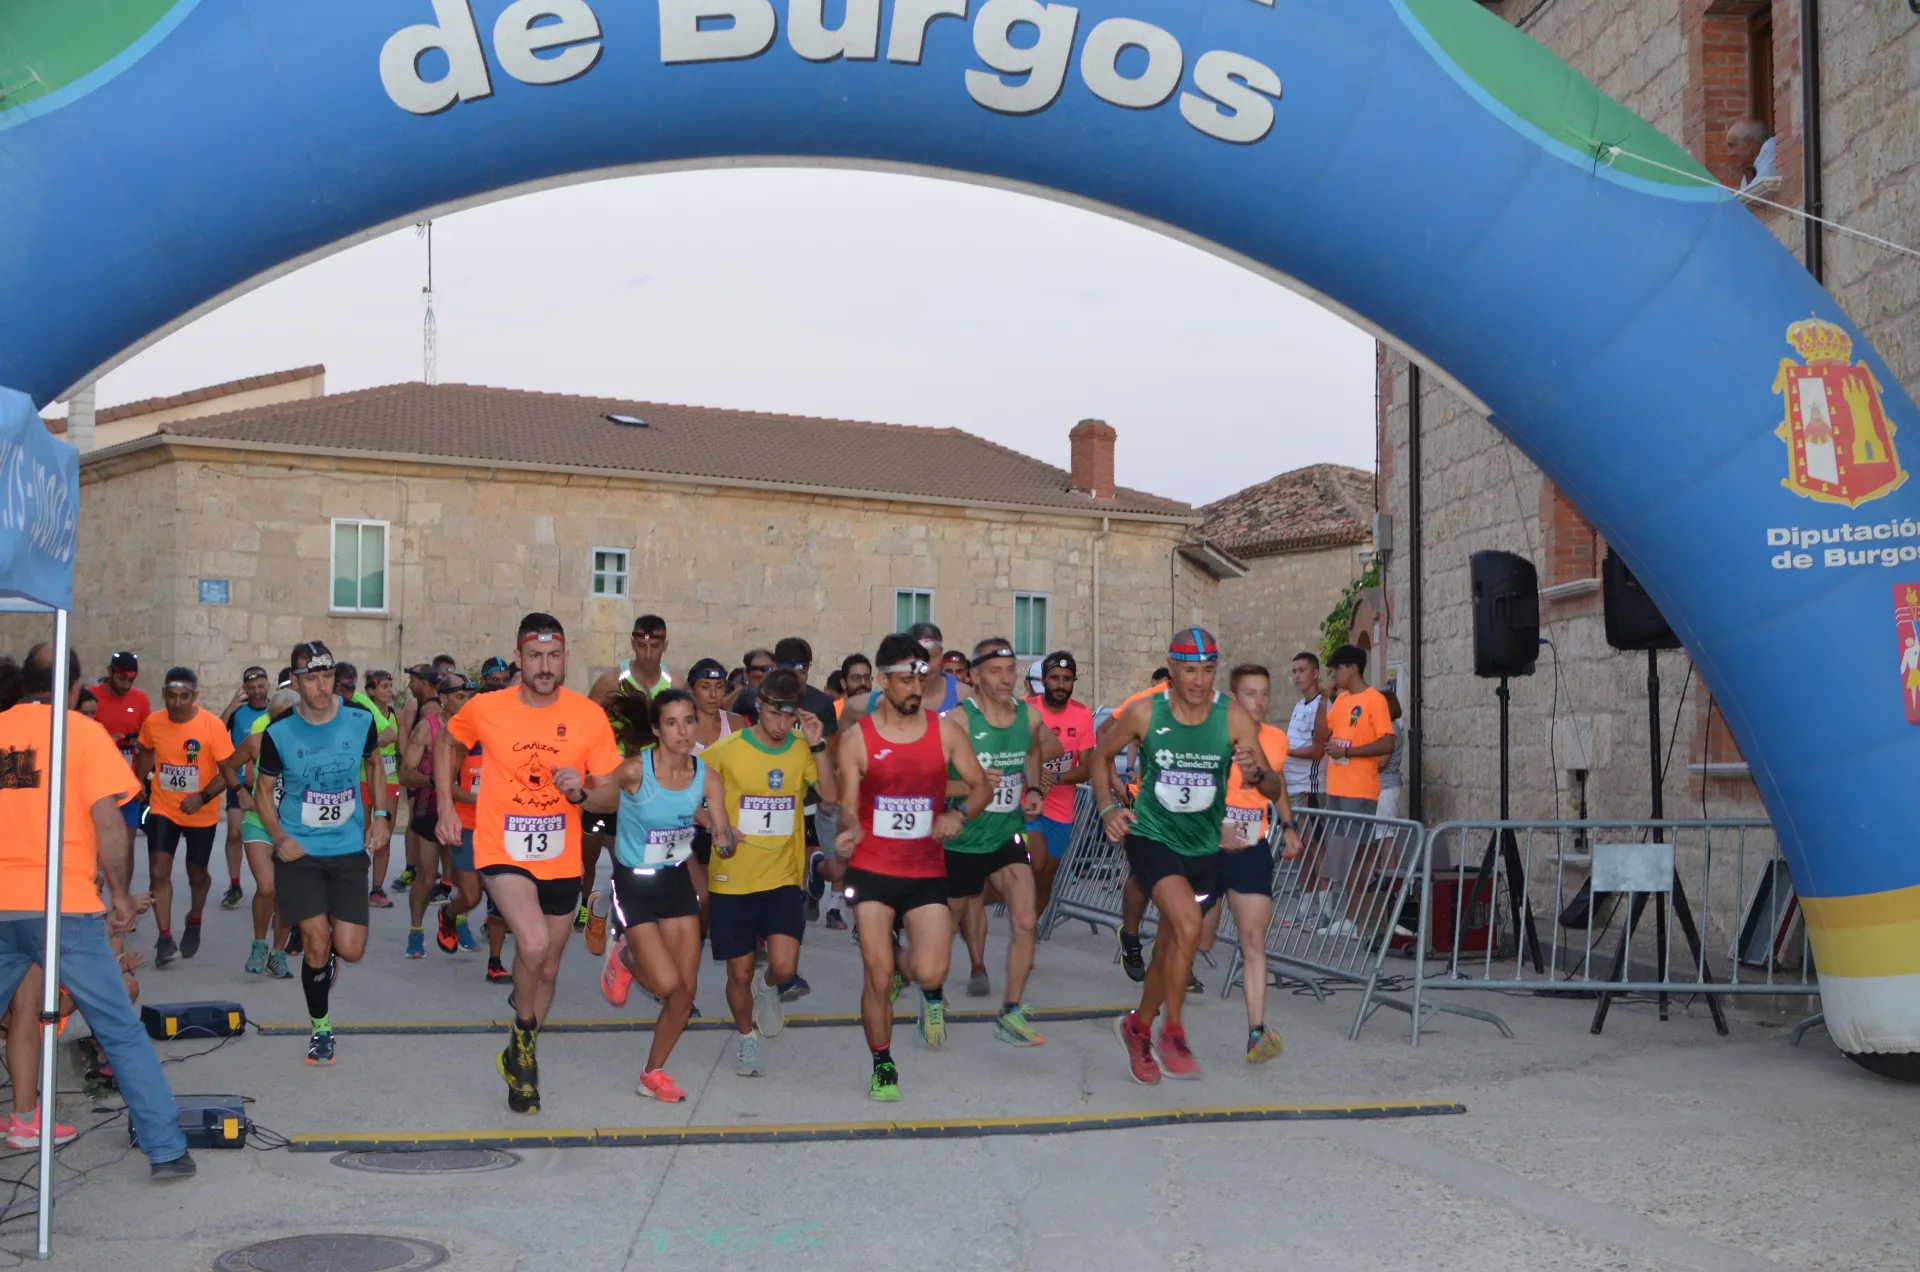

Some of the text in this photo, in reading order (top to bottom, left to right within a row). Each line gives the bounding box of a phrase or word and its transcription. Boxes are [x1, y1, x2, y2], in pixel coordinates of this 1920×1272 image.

[379, 0, 603, 116] de
[1767, 518, 1920, 549] Diputació
[1771, 545, 1920, 570] de Burgo
[513, 741, 559, 754] Cañizar
[1161, 770, 1213, 779] DIPUTACIÓN
[170, 776, 186, 787] 46
[1161, 776, 1213, 786] BURGOS
[307, 789, 353, 799] DIPUTACIÓN
[1179, 787, 1190, 804] 3
[307, 795, 353, 805] BURGOS
[879, 797, 930, 805] DIPUTACIÓN
[744, 802, 792, 810] BURGOS
[879, 803, 929, 811] BURGOS
[318, 806, 341, 821] 28
[1227, 811, 1260, 821] URGOS
[509, 816, 562, 825] DIPUTACIÓN
[763, 812, 771, 828] 1
[891, 813, 915, 830] 29
[508, 822, 563, 831] BURGOS
[524, 833, 548, 852] 13
[665, 842, 675, 859] 2
